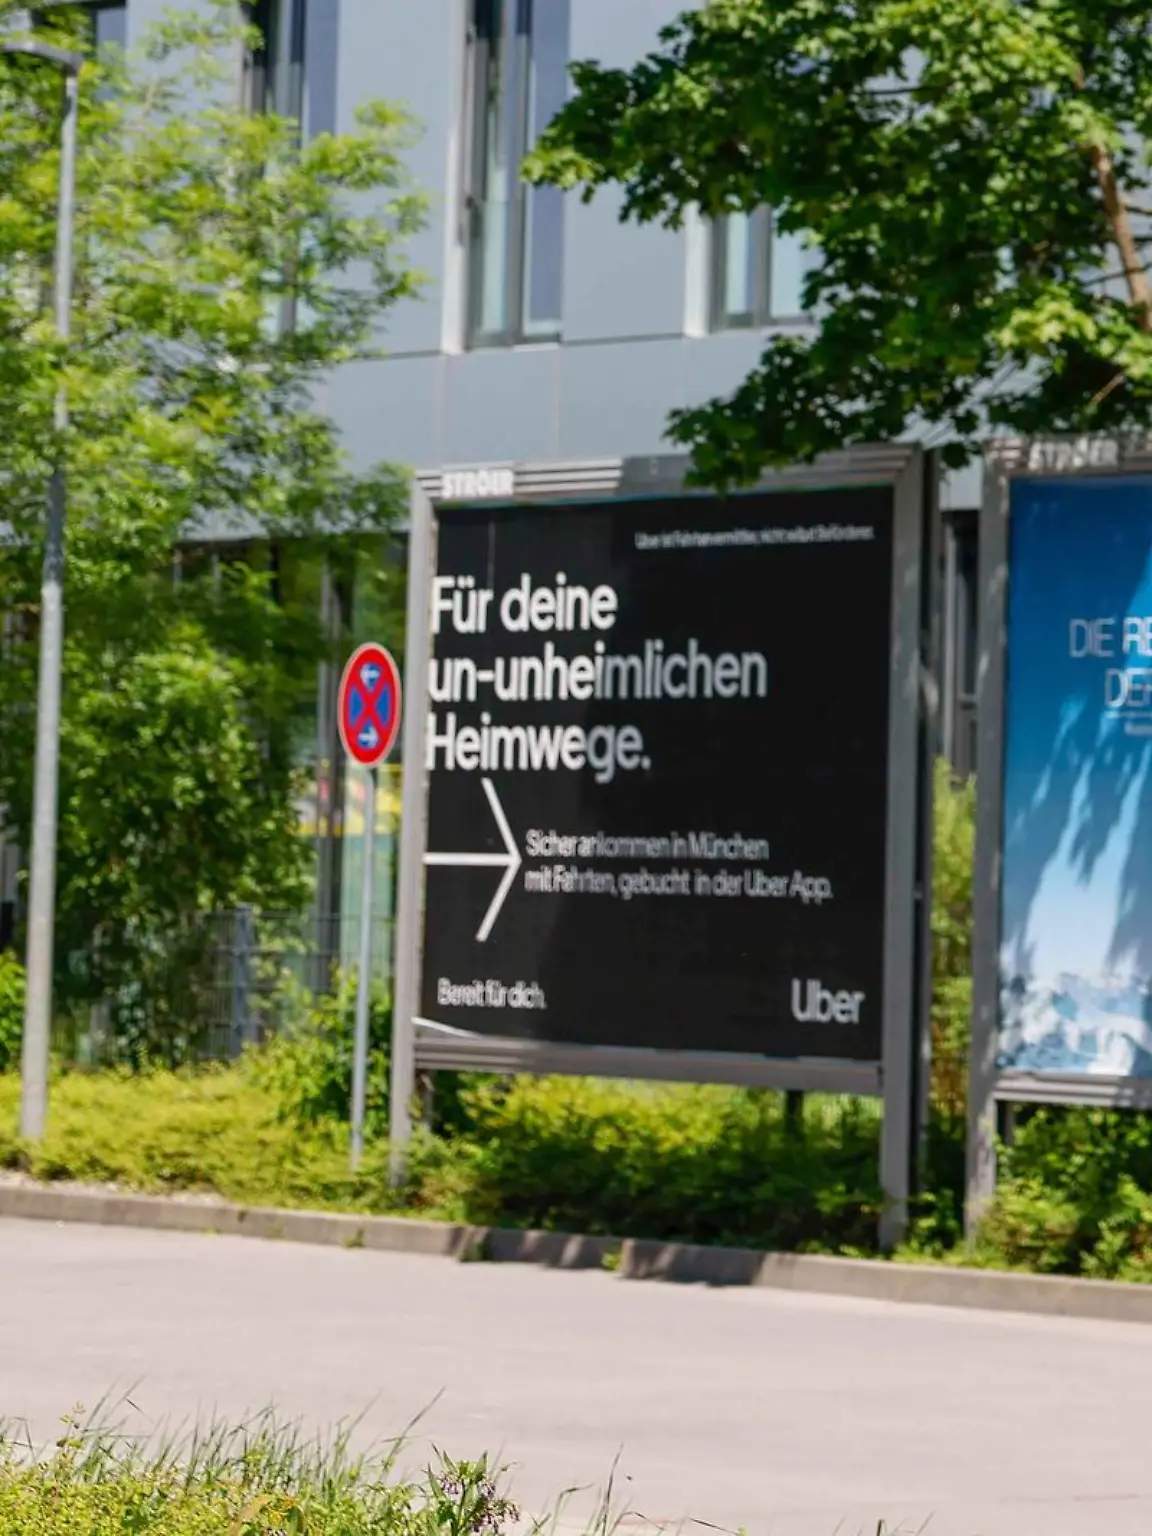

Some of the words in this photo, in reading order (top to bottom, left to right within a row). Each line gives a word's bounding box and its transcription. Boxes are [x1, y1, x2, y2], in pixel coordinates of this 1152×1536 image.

[430, 575, 494, 634] Für
[499, 572, 619, 632] deine
[1068, 618, 1116, 658] DIE
[427, 637, 768, 703] un-unheimlichen
[425, 711, 651, 784] Heimwege.
[525, 827, 577, 858] Sicher
[577, 830, 670, 859] ankommen
[670, 830, 688, 859] in
[687, 830, 770, 861] München
[524, 864, 552, 893] mit
[552, 863, 618, 898] Fahrten,
[617, 866, 692, 901] gebucht
[693, 867, 712, 897] in
[711, 868, 744, 898] der
[743, 868, 790, 899] Uber
[788, 868, 834, 906] App.
[791, 977, 866, 1024] Uber
